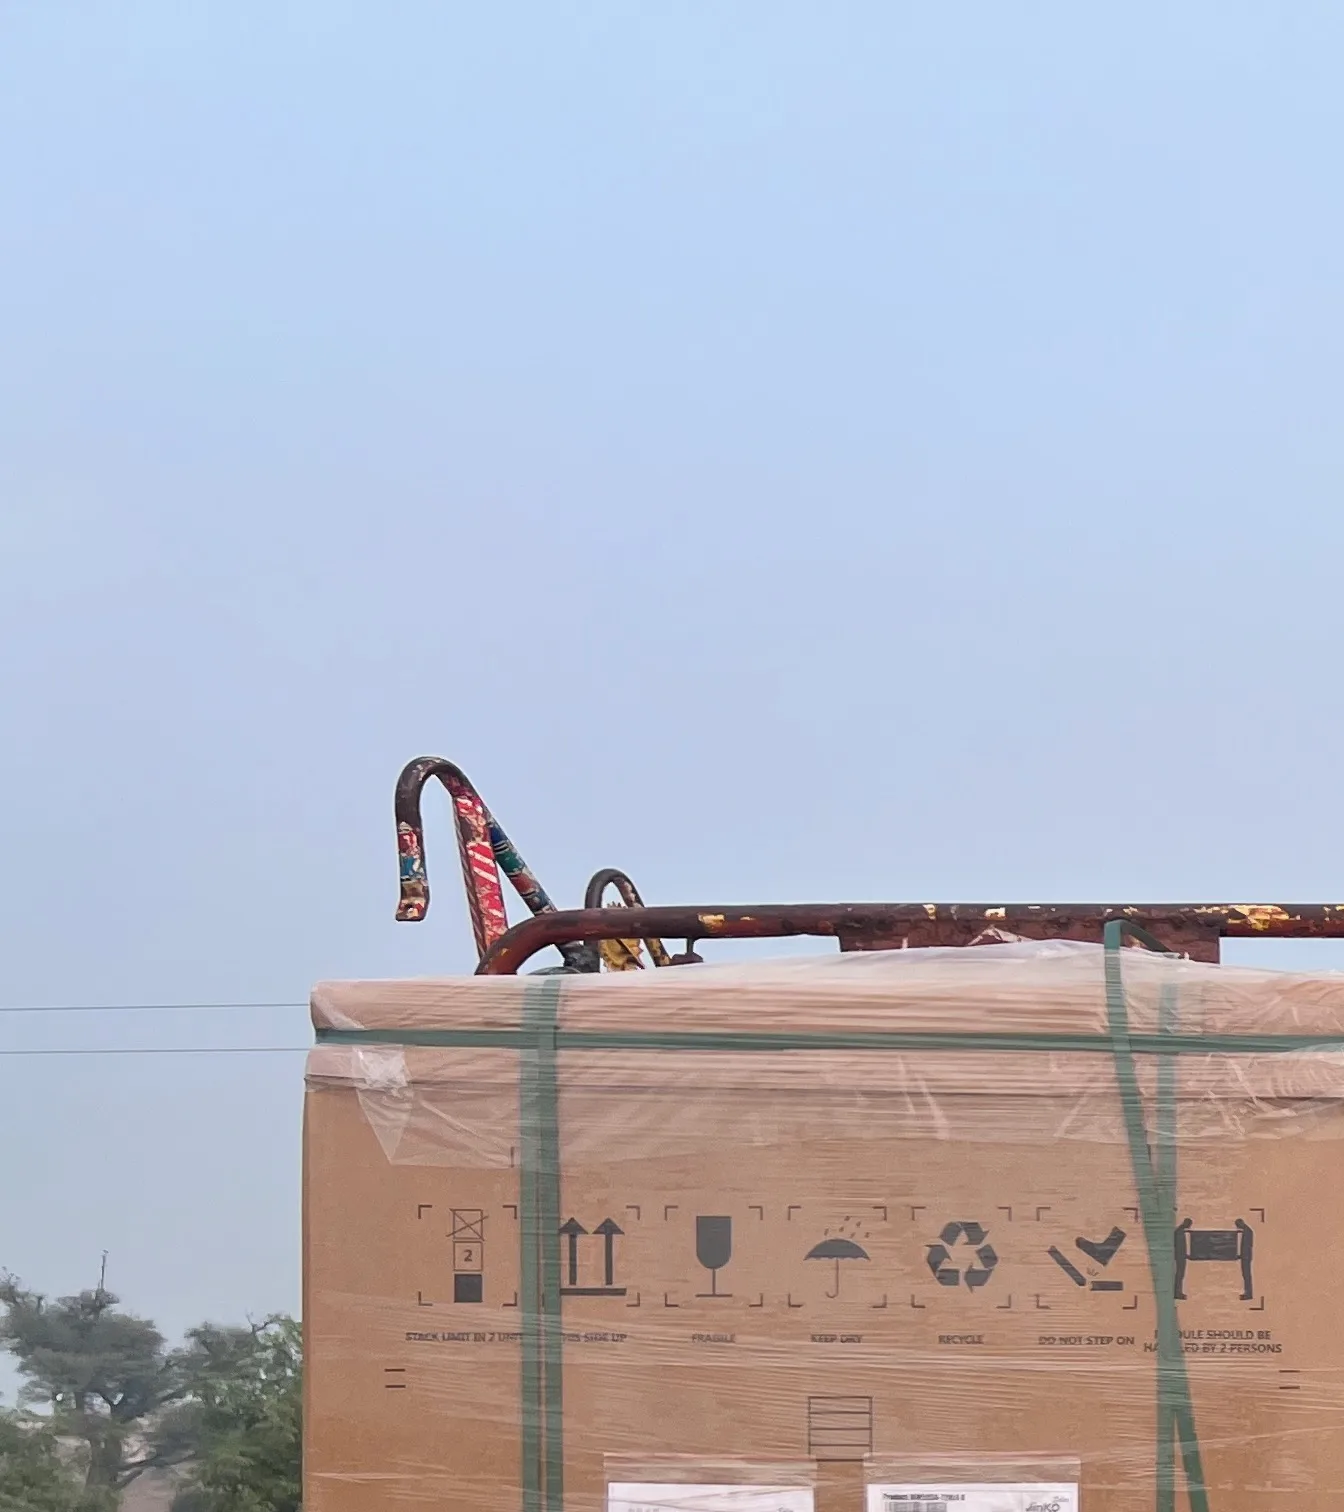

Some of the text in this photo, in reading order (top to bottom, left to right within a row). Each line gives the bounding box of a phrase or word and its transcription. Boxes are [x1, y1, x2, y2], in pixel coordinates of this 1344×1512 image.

[464, 1249, 472, 1262] 2
[405, 1332, 438, 1342] STACK
[442, 1332, 470, 1342] LIMIT
[474, 1332, 485, 1342] IN
[488, 1332, 495, 1342] 2
[585, 1332, 608, 1343] SIDE
[611, 1332, 627, 1343] UP
[691, 1333, 736, 1343] FRAGILE
[810, 1334, 862, 1343] KEEP DRY
[938, 1334, 984, 1344] RECYCLE
[1206, 1330, 1254, 1340] SHOULD
[1257, 1330, 1272, 1340] BE
[1038, 1336, 1135, 1345] DO NOT STEP ON
[1202, 1343, 1217, 1353] BY
[1219, 1343, 1227, 1353] 2
[1229, 1343, 1283, 1353] PERSONS
